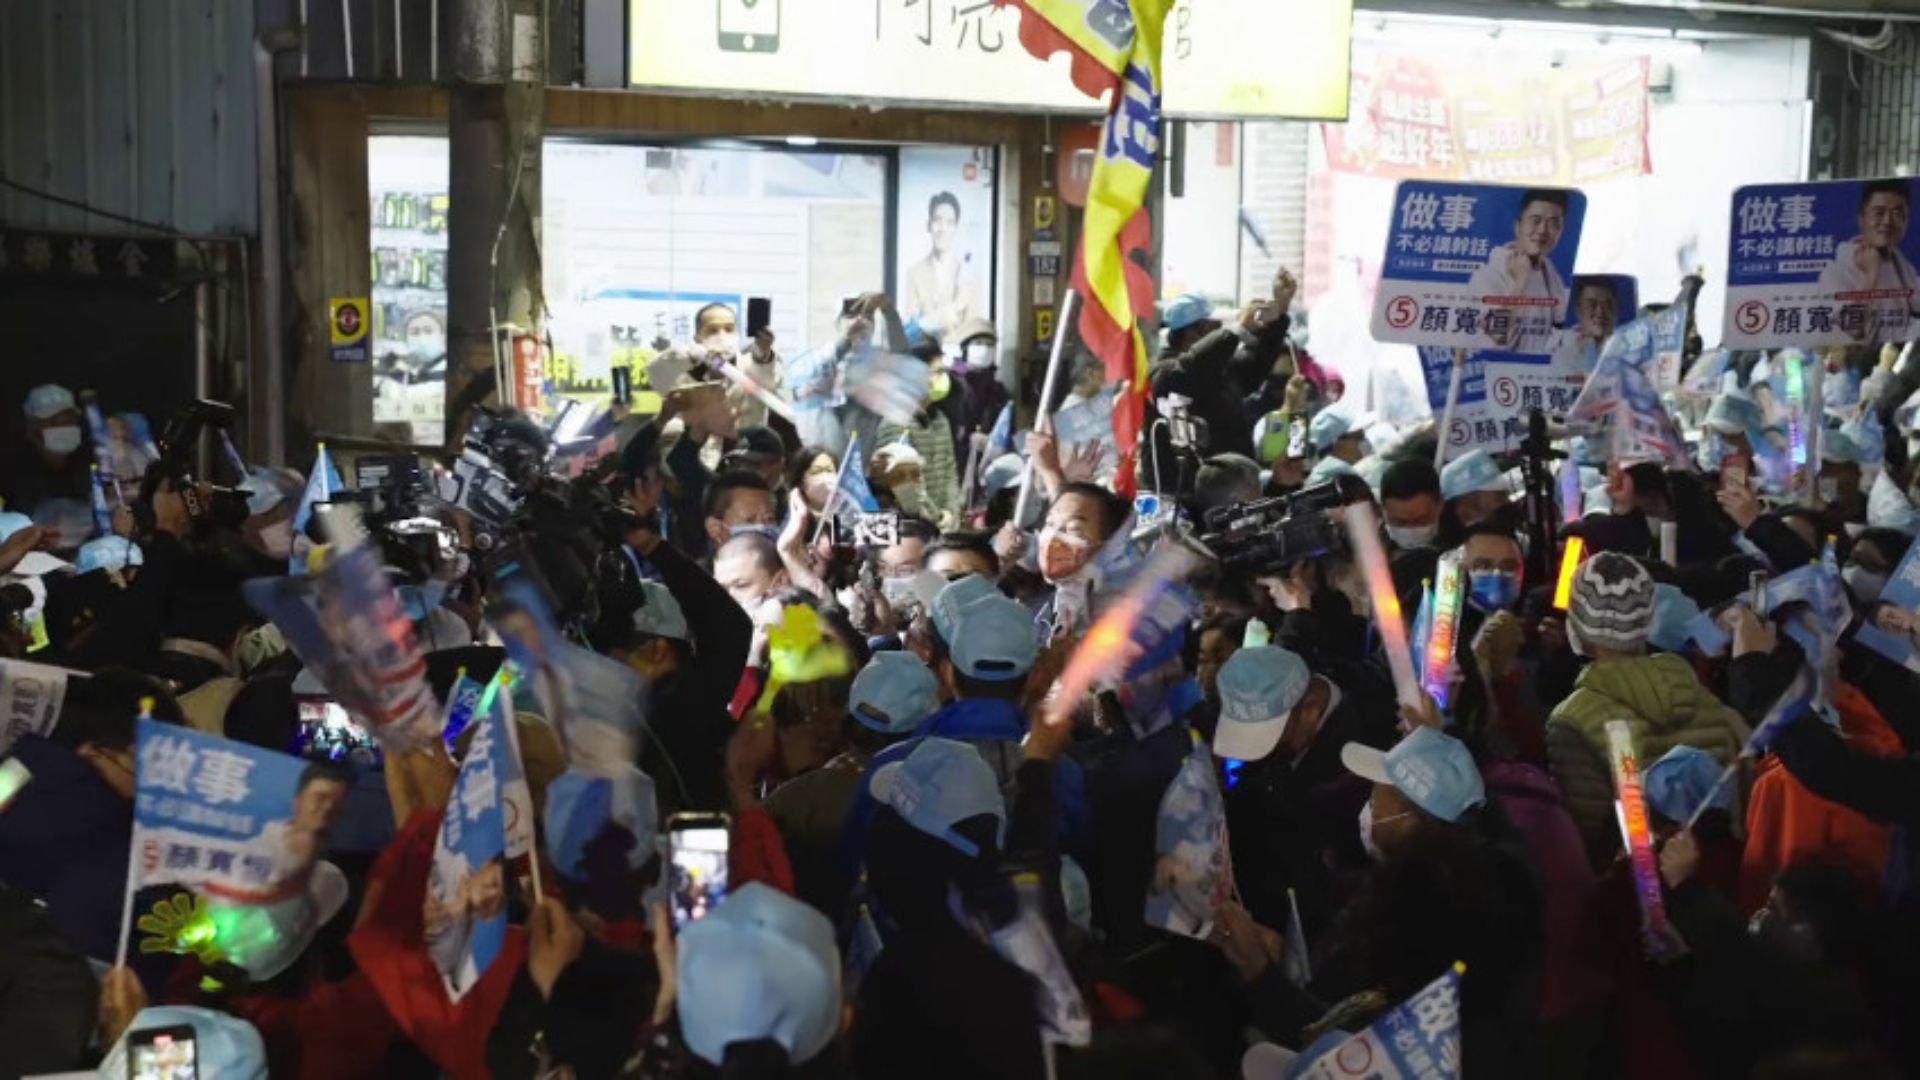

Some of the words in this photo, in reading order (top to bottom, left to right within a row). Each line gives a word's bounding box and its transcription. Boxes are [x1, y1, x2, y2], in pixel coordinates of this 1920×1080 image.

[1401, 192, 1478, 232] 做事
[1739, 195, 1816, 235] 做事
[142, 735, 255, 804] 做事
